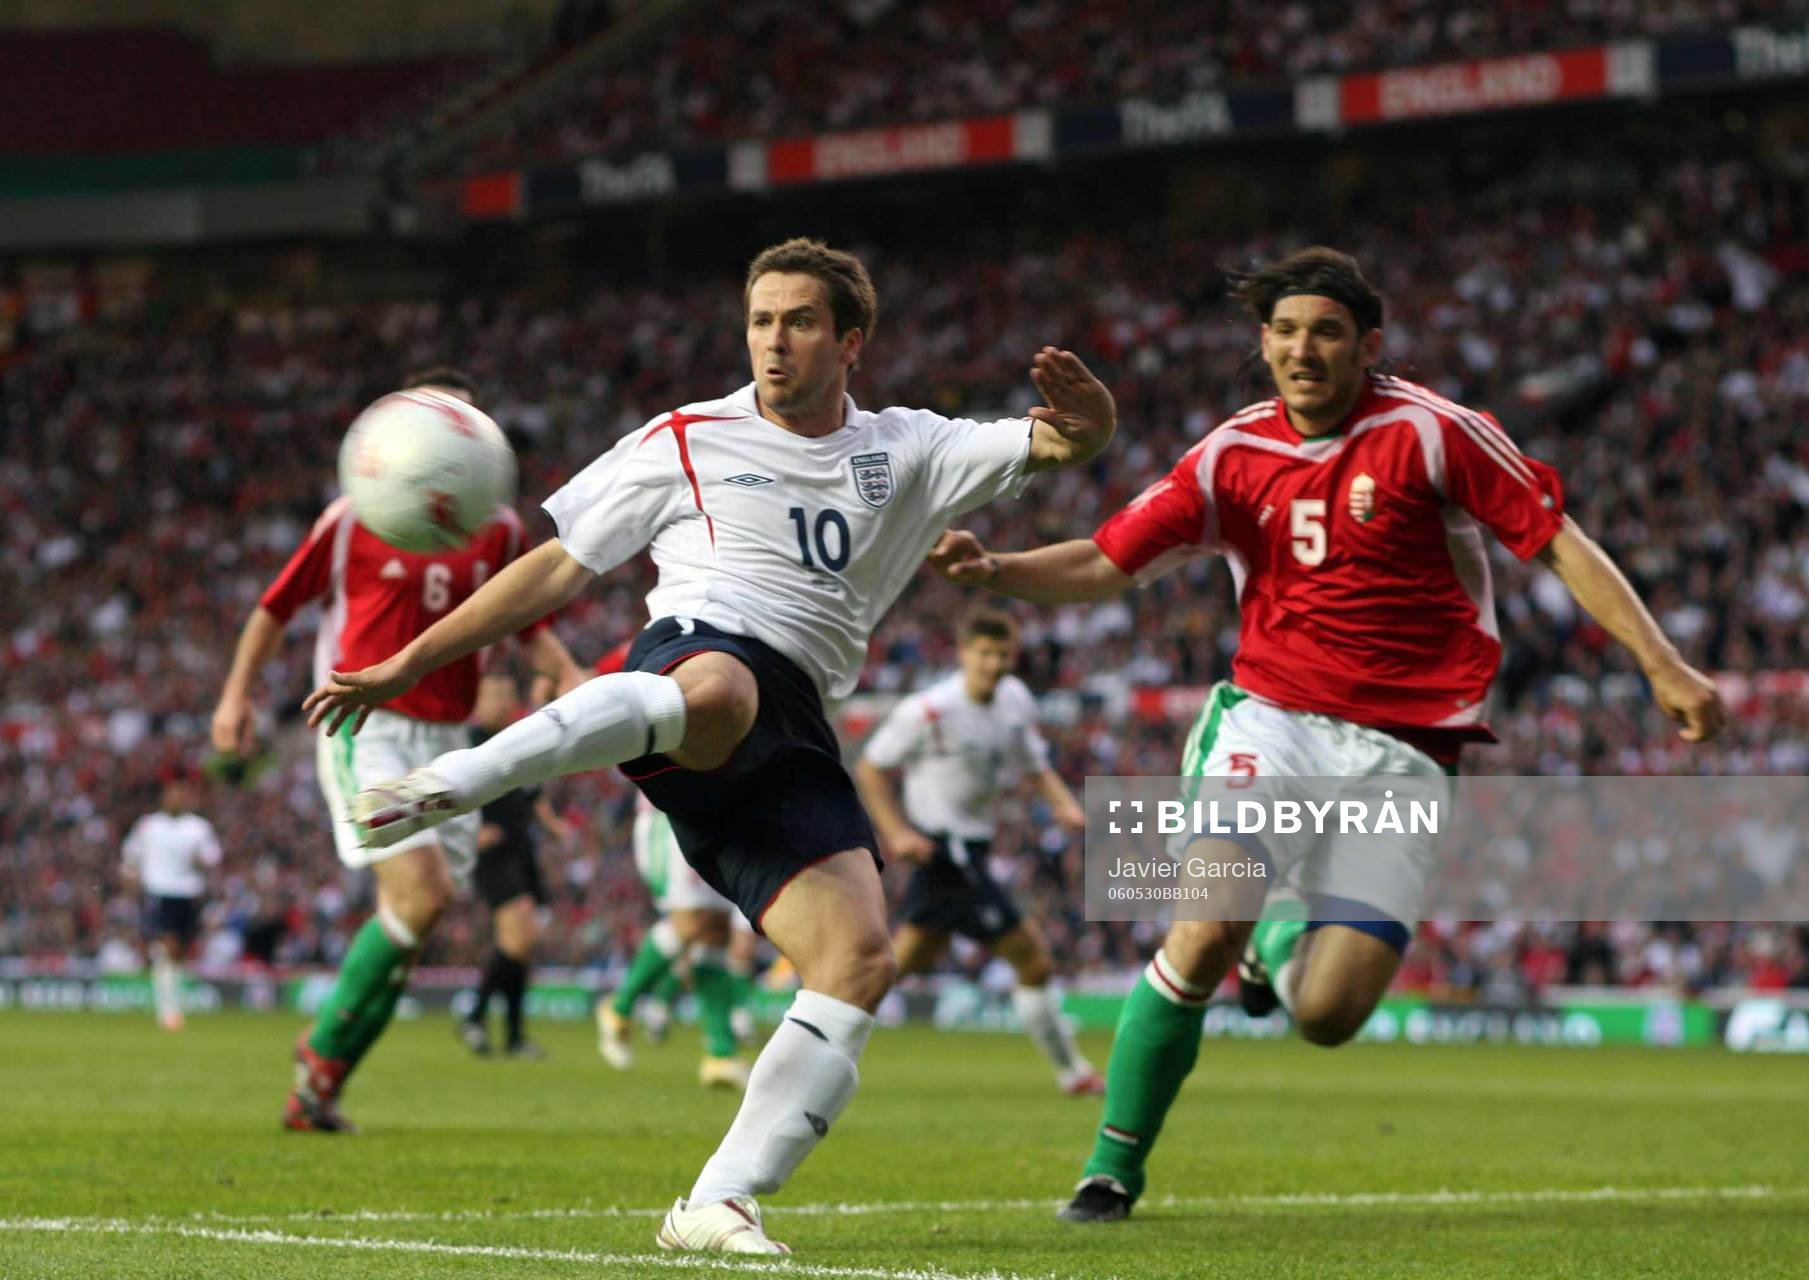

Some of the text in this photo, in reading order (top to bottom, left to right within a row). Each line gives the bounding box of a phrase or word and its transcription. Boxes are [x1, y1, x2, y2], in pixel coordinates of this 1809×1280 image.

[1380, 55, 1563, 117] ENGLAND
[788, 507, 850, 572] 10
[1291, 500, 1327, 566] 5
[424, 563, 451, 611] 6
[1226, 753, 1258, 789] 5
